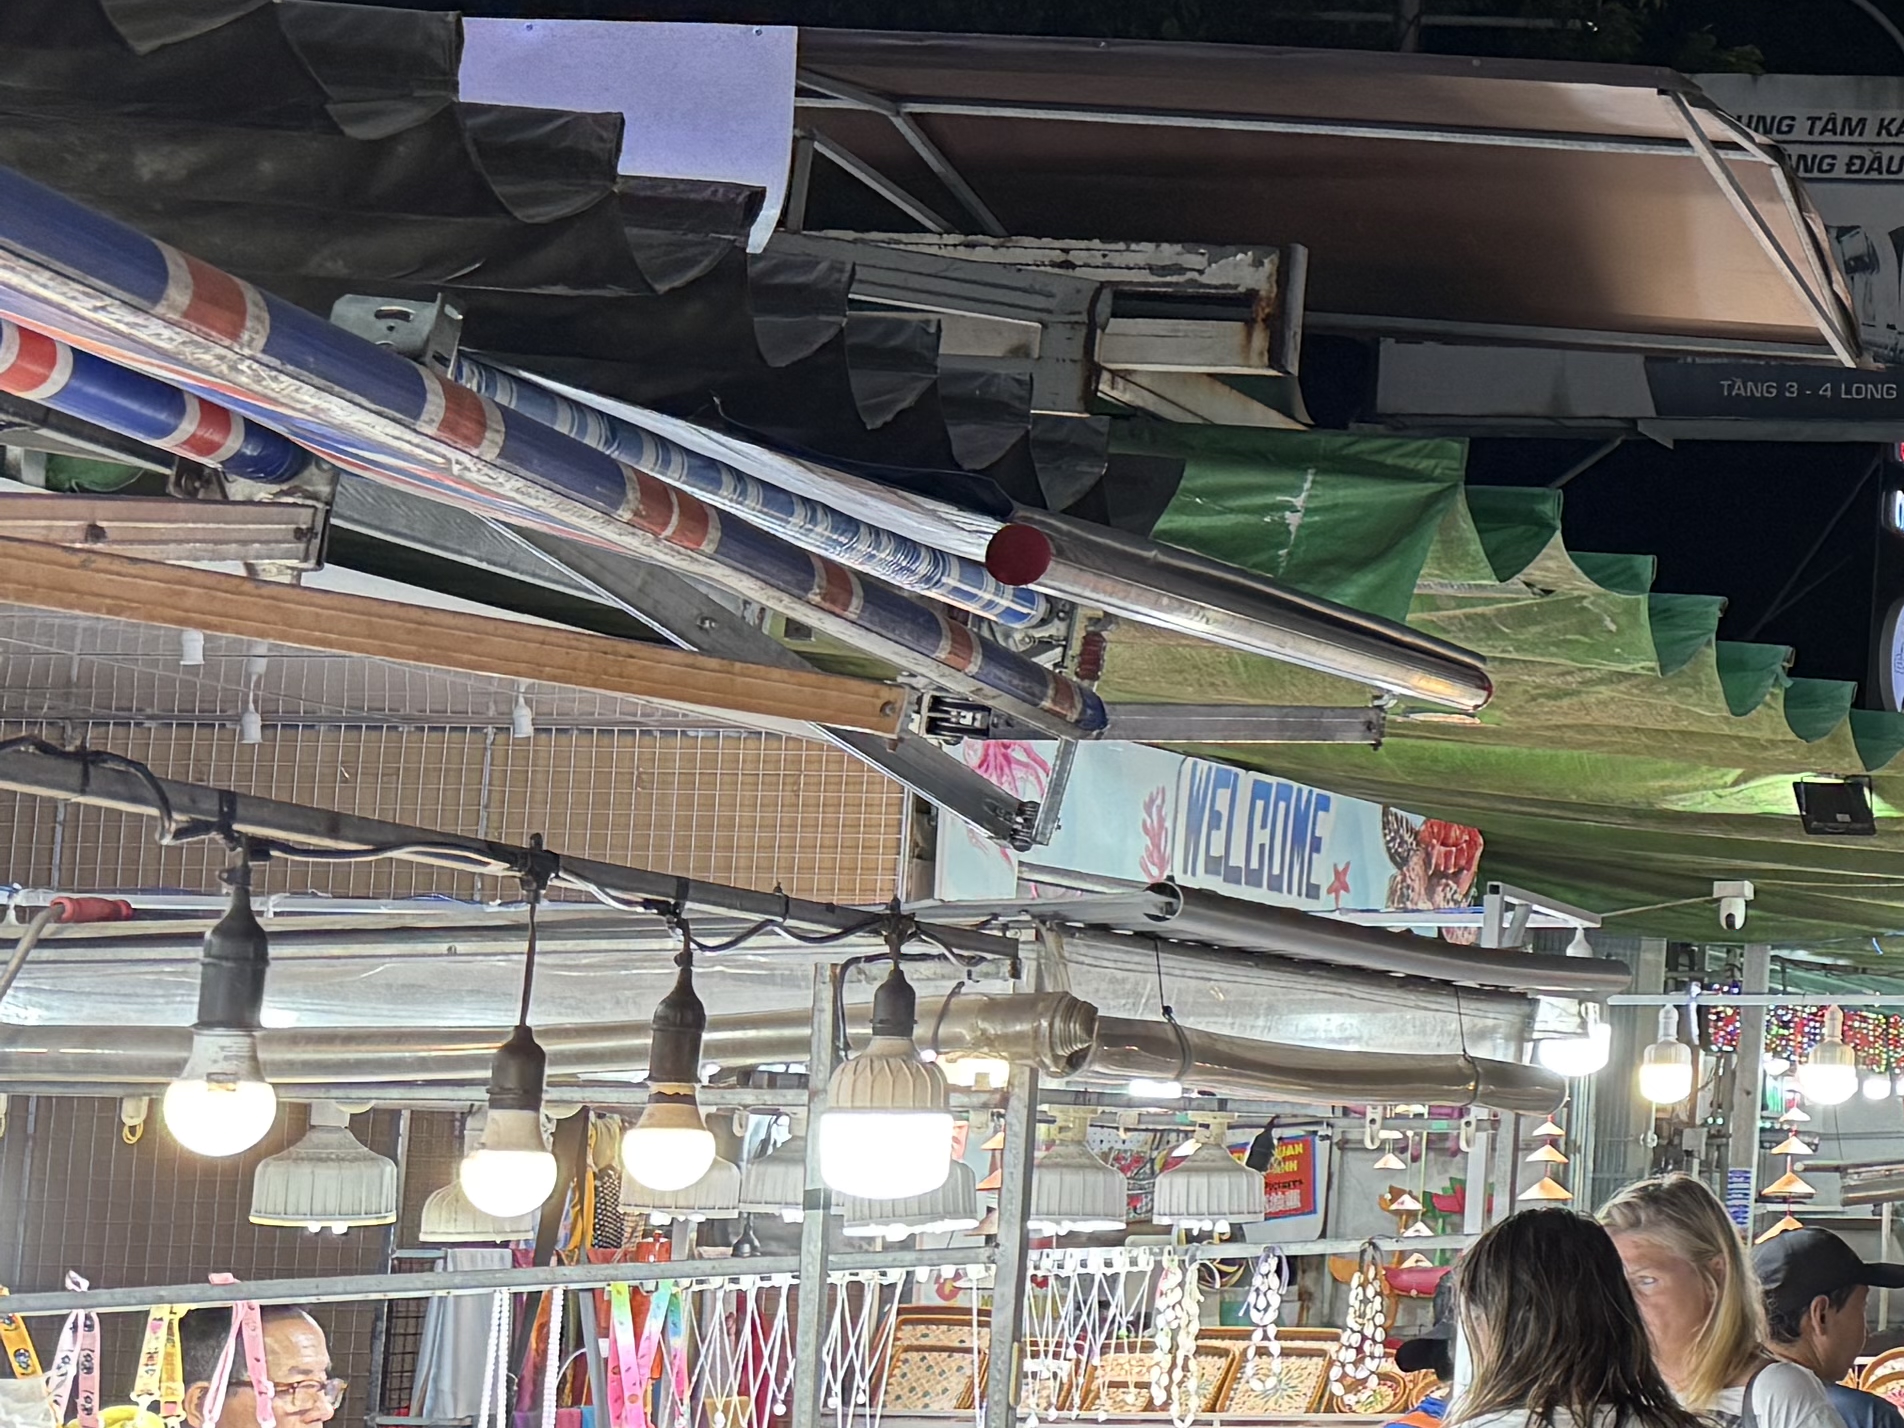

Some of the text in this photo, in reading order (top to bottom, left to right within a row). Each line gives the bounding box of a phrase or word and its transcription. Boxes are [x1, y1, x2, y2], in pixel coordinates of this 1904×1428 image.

[1806, 112, 1867, 138] TÂM
[1720, 375, 1778, 399] TẦNG
[1785, 381, 1799, 398] 3
[1818, 382, 1832, 399] 4
[1841, 383, 1898, 400] LONG
[1181, 758, 1331, 903] WELCOME
